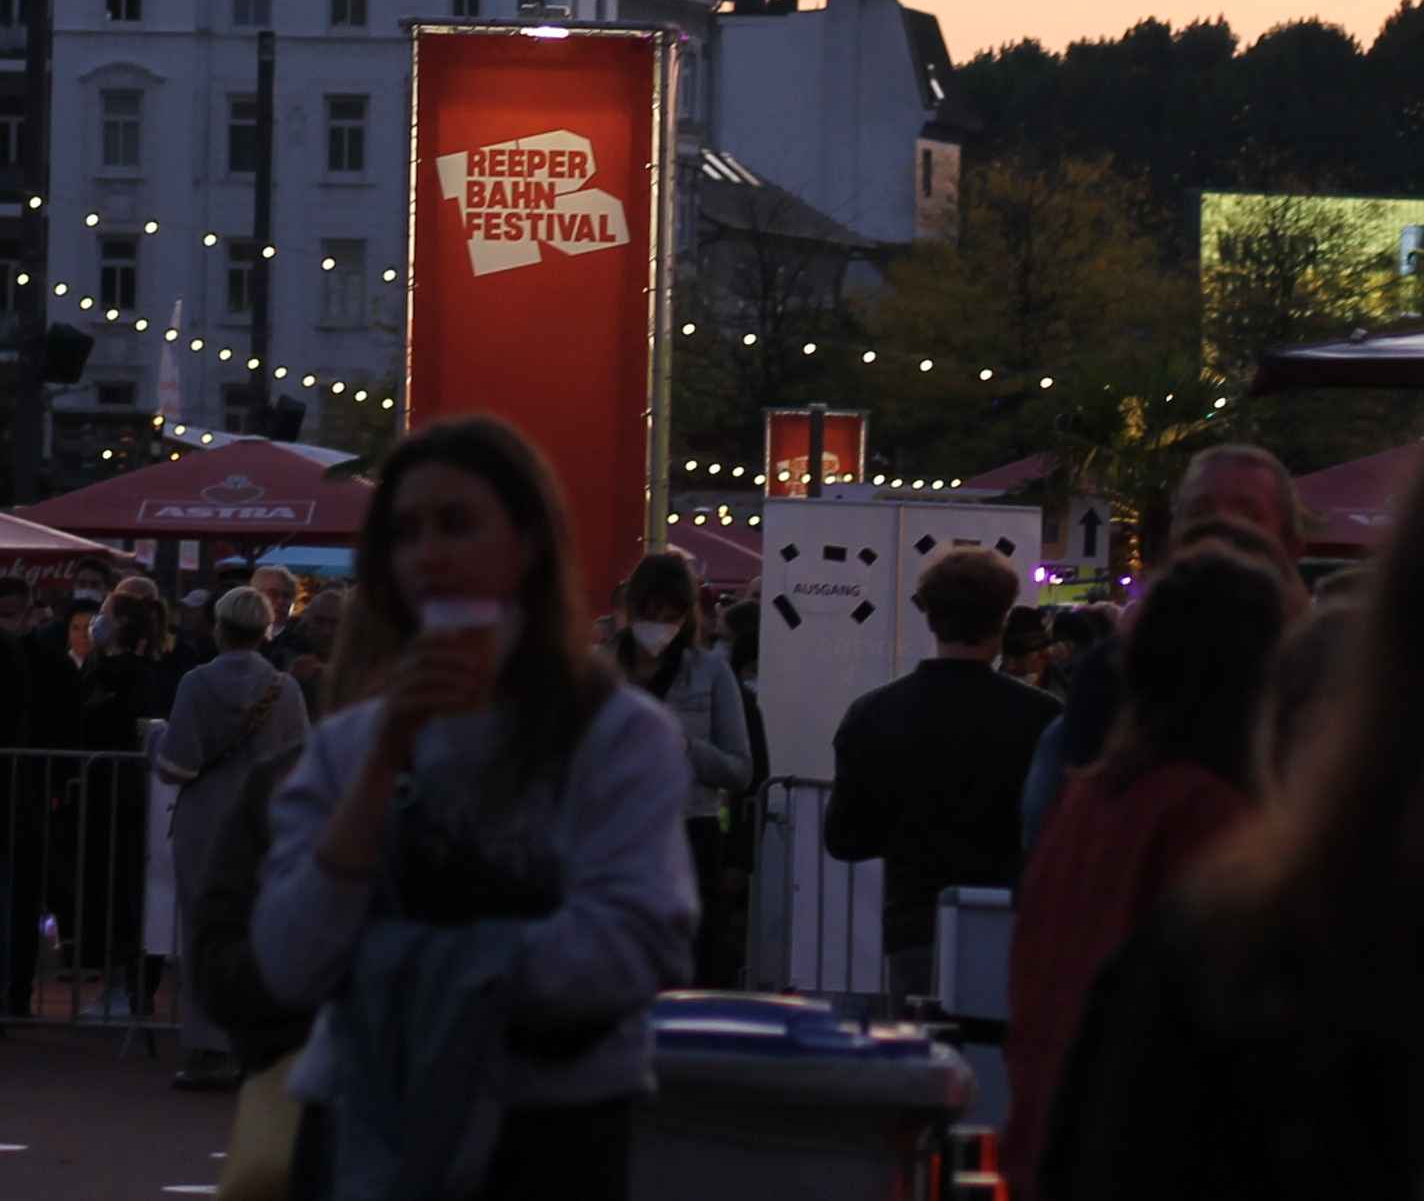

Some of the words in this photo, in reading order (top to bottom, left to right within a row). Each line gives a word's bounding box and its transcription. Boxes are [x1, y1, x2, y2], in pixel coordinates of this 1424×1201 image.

[466, 148, 588, 179] REEPER
[465, 180, 556, 210] BAHN
[465, 211, 616, 243] FESTIVAL
[154, 506, 296, 519] ASTRA
[793, 583, 860, 597] AUSGANG
